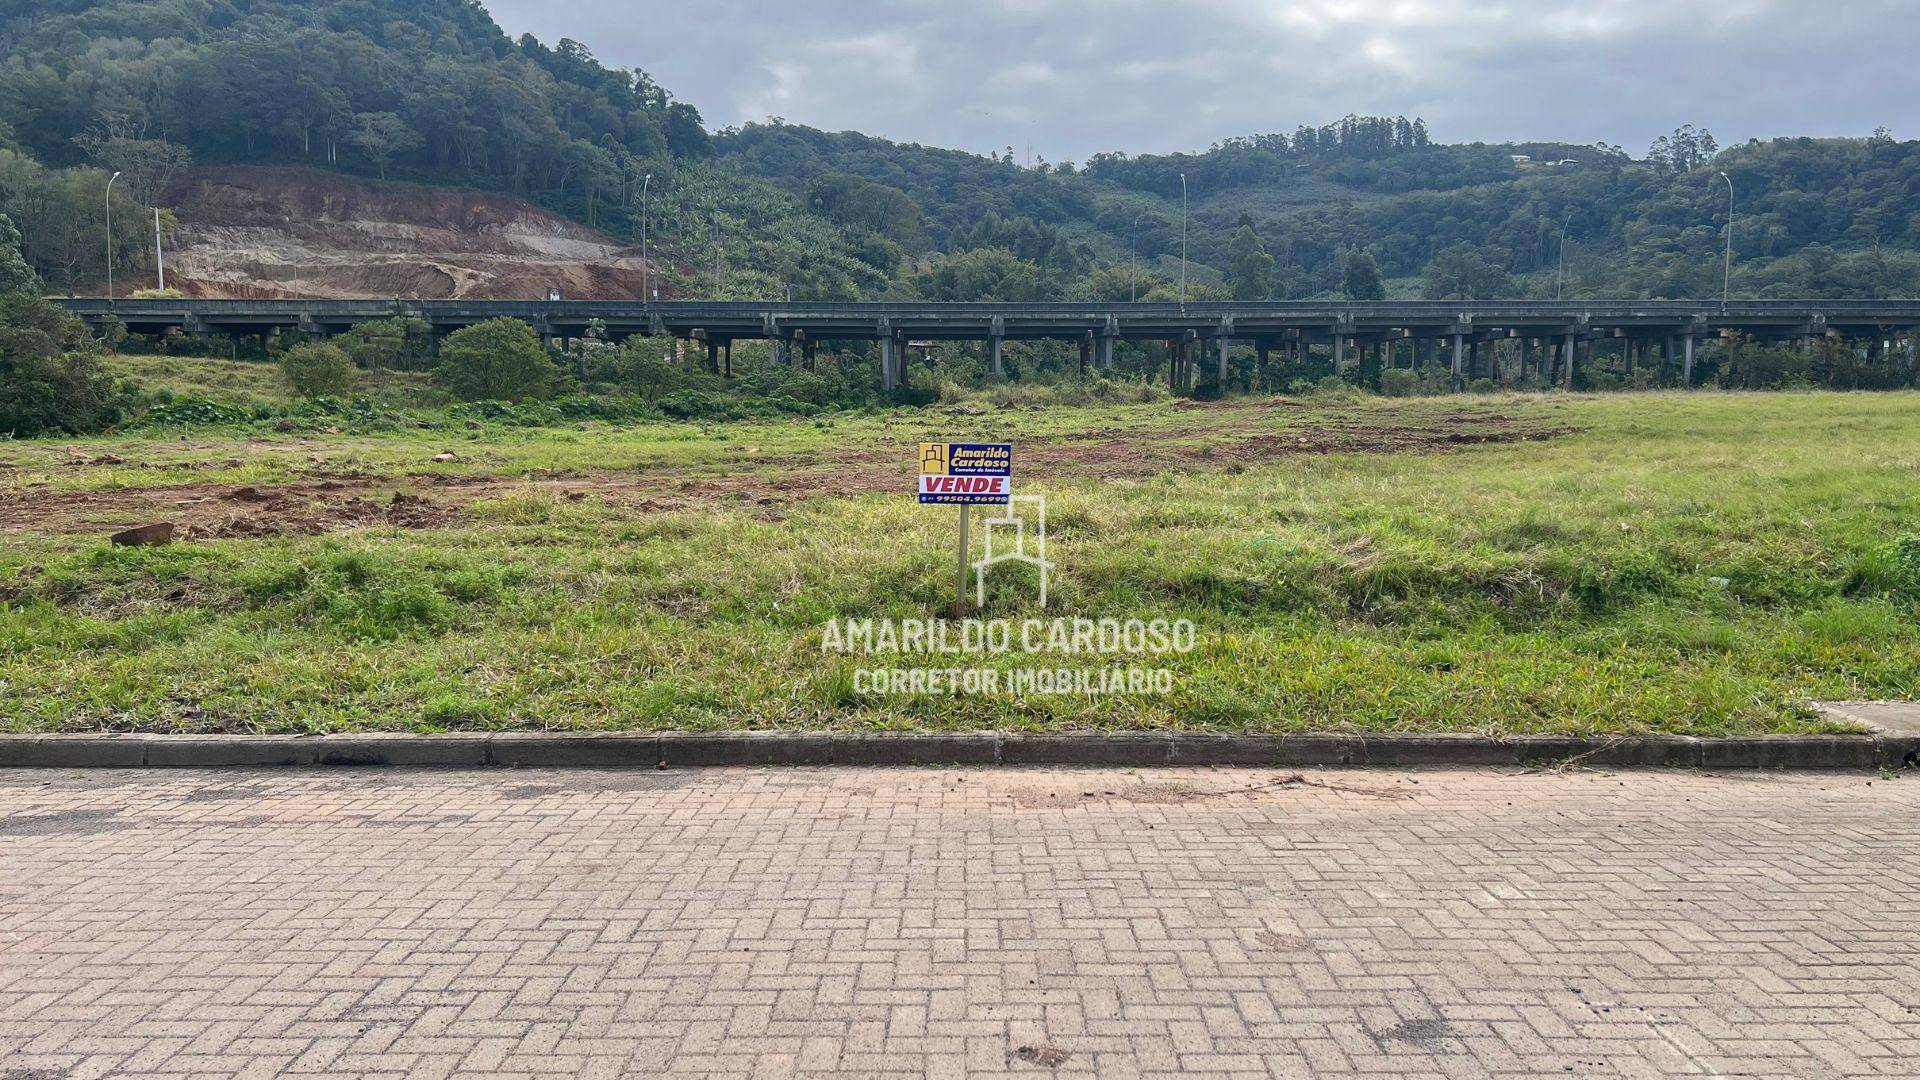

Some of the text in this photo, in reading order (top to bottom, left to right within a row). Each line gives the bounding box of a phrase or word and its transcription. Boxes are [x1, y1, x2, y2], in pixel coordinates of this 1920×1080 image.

[953, 447, 1009, 458] Amarildo
[951, 458, 1009, 467] Cardoso
[925, 477, 1004, 492] VENDE
